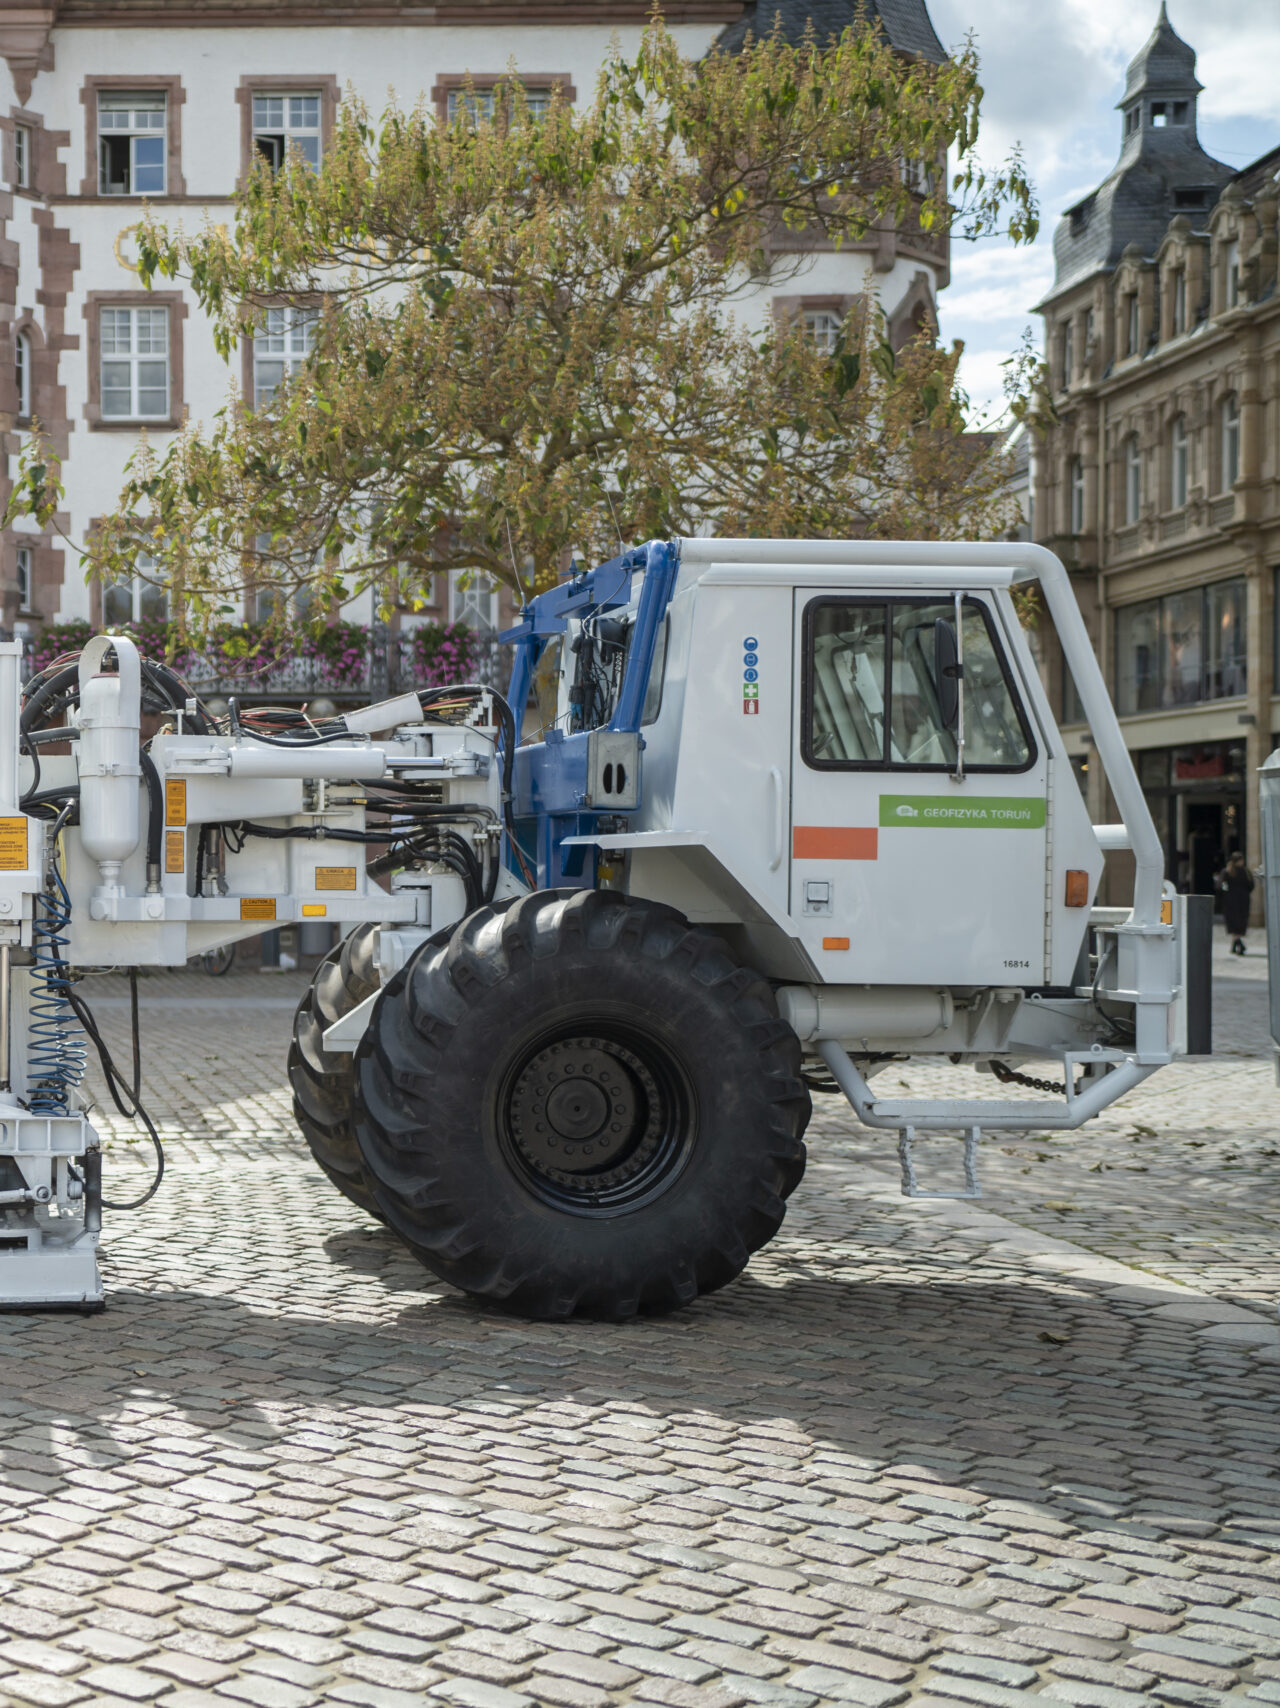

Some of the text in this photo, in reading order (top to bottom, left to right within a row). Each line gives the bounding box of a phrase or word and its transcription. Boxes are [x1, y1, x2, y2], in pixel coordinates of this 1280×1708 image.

[923, 808, 1031, 820] GEOFIZYKA TORUŃ
[1003, 960, 1030, 968] 16814
